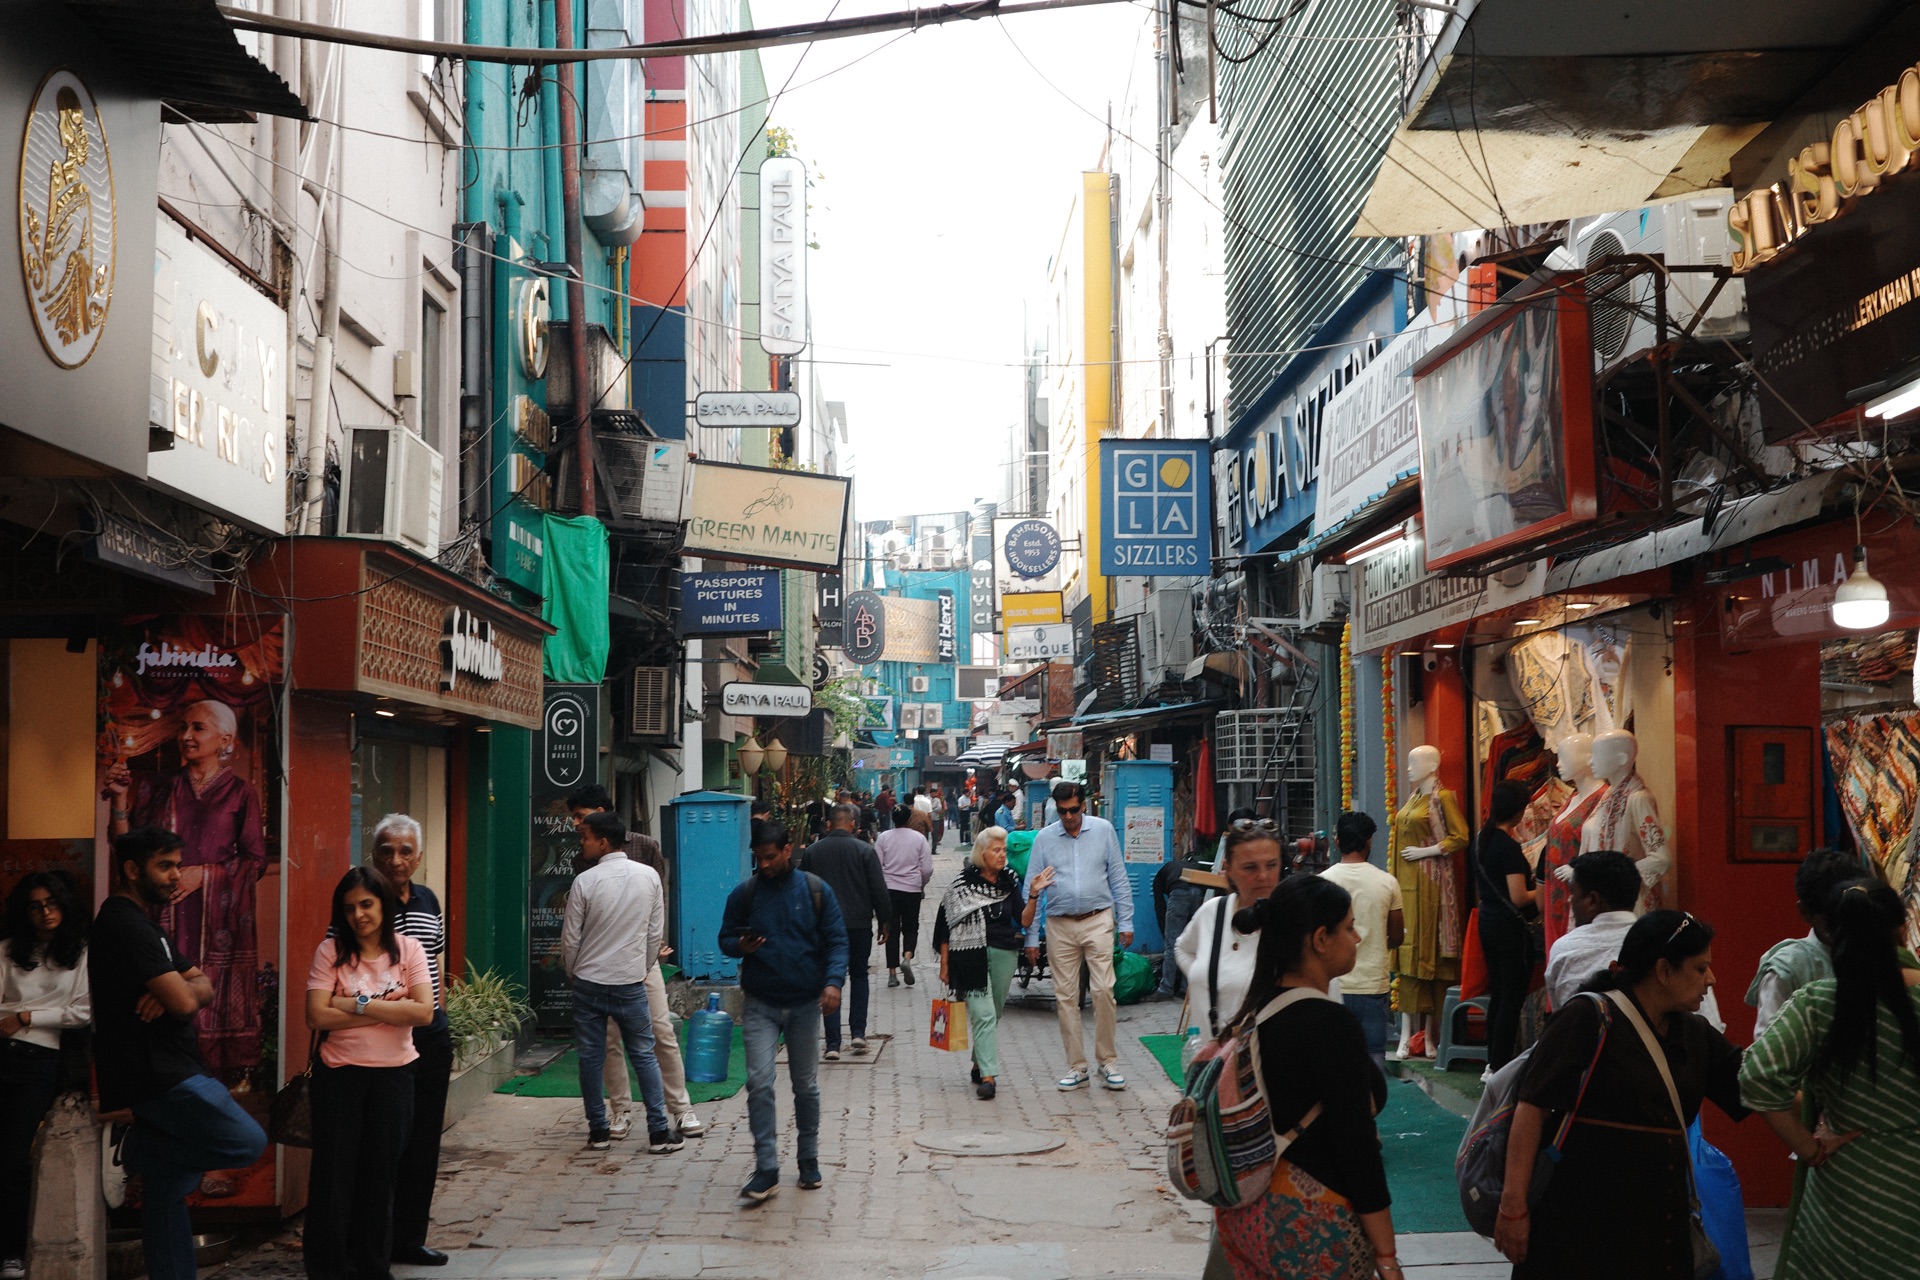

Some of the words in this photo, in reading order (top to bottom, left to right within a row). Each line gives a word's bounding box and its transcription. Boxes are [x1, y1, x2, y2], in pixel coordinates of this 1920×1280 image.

[772, 170, 793, 243] PAUL
[772, 252, 793, 340] SATYA
[700, 403, 751, 416] SATYA
[754, 403, 797, 416] PAUL
[1334, 374, 1374, 454] FOOTWEAR
[1244, 416, 1294, 529] GOLA
[1332, 432, 1372, 494] ARTIFICIAL
[690, 516, 755, 541] GREEN
[763, 524, 837, 552] MANTIS
[1008, 523, 1058, 547] BAHRISONS
[1023, 539, 1042, 547] Estd.
[1008, 549, 1058, 573] BOOKSELLERS
[1024, 549, 1040, 557] 1953
[1114, 544, 1198, 566] SIZZLERS
[694, 576, 765, 589] PASSPORT
[1364, 545, 1411, 602] FOOTWEAR
[697, 588, 763, 600] PICTURES
[701, 613, 760, 625] MINUTES
[723, 602, 737, 612] IN
[938, 595, 952, 638] blend
[1366, 589, 1415, 632] ARTIFICIAL
[136, 641, 238, 676] fabindia
[449, 605, 503, 691] fabindia
[1013, 643, 1070, 657] CHIQUE
[726, 693, 771, 706] SATYA
[773, 694, 809, 709] PAUL
